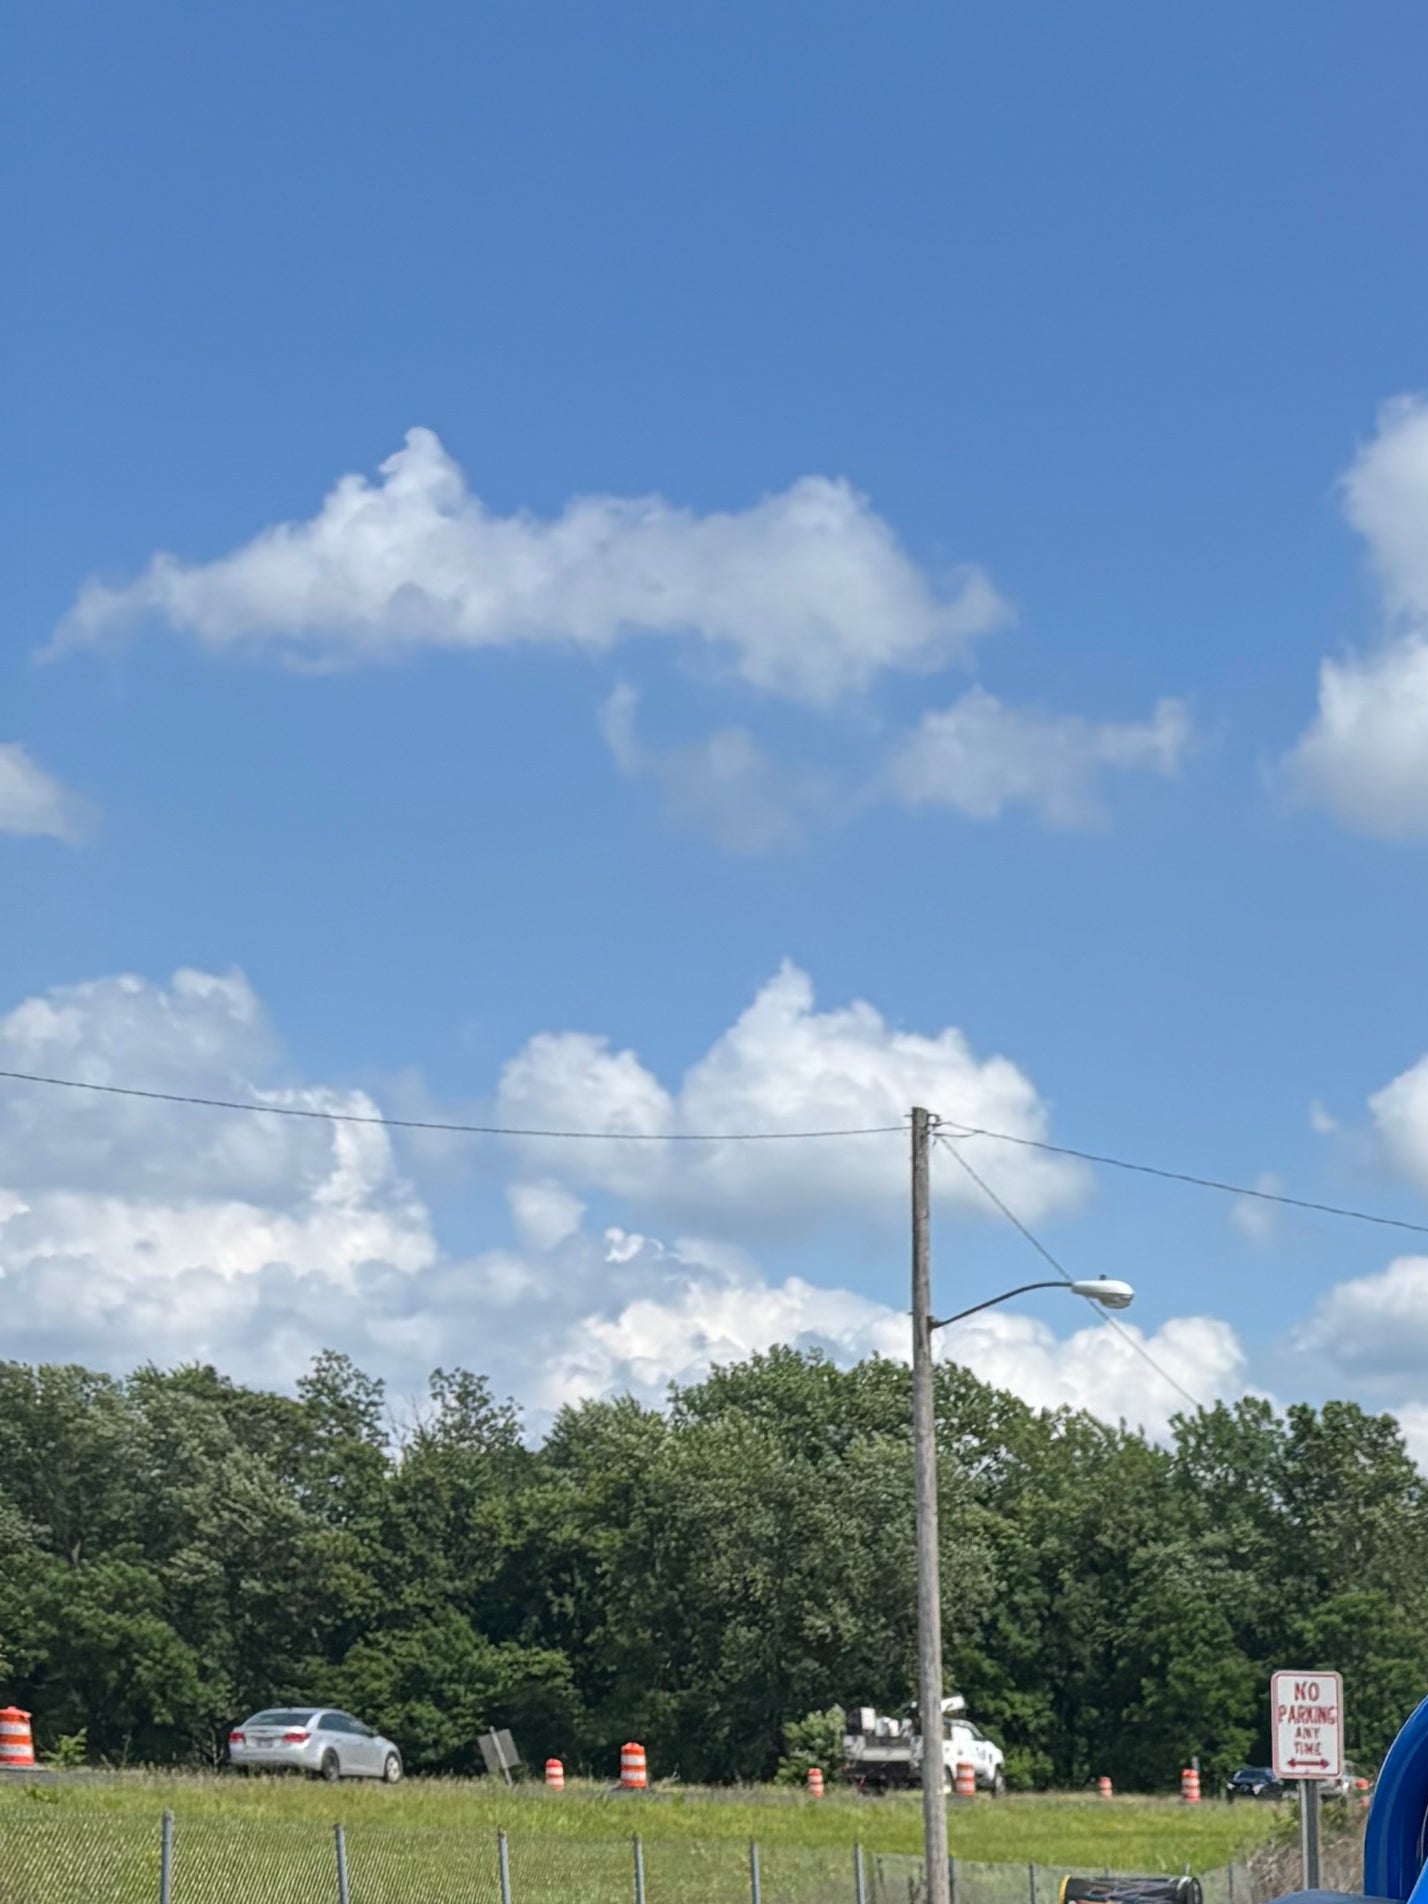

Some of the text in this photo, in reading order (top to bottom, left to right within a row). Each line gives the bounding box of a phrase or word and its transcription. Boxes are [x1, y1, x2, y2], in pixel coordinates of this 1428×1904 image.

[1294, 1681, 1320, 1702] NO
[1278, 1704, 1337, 1725] PARKING
[1294, 1727, 1320, 1739] ANY
